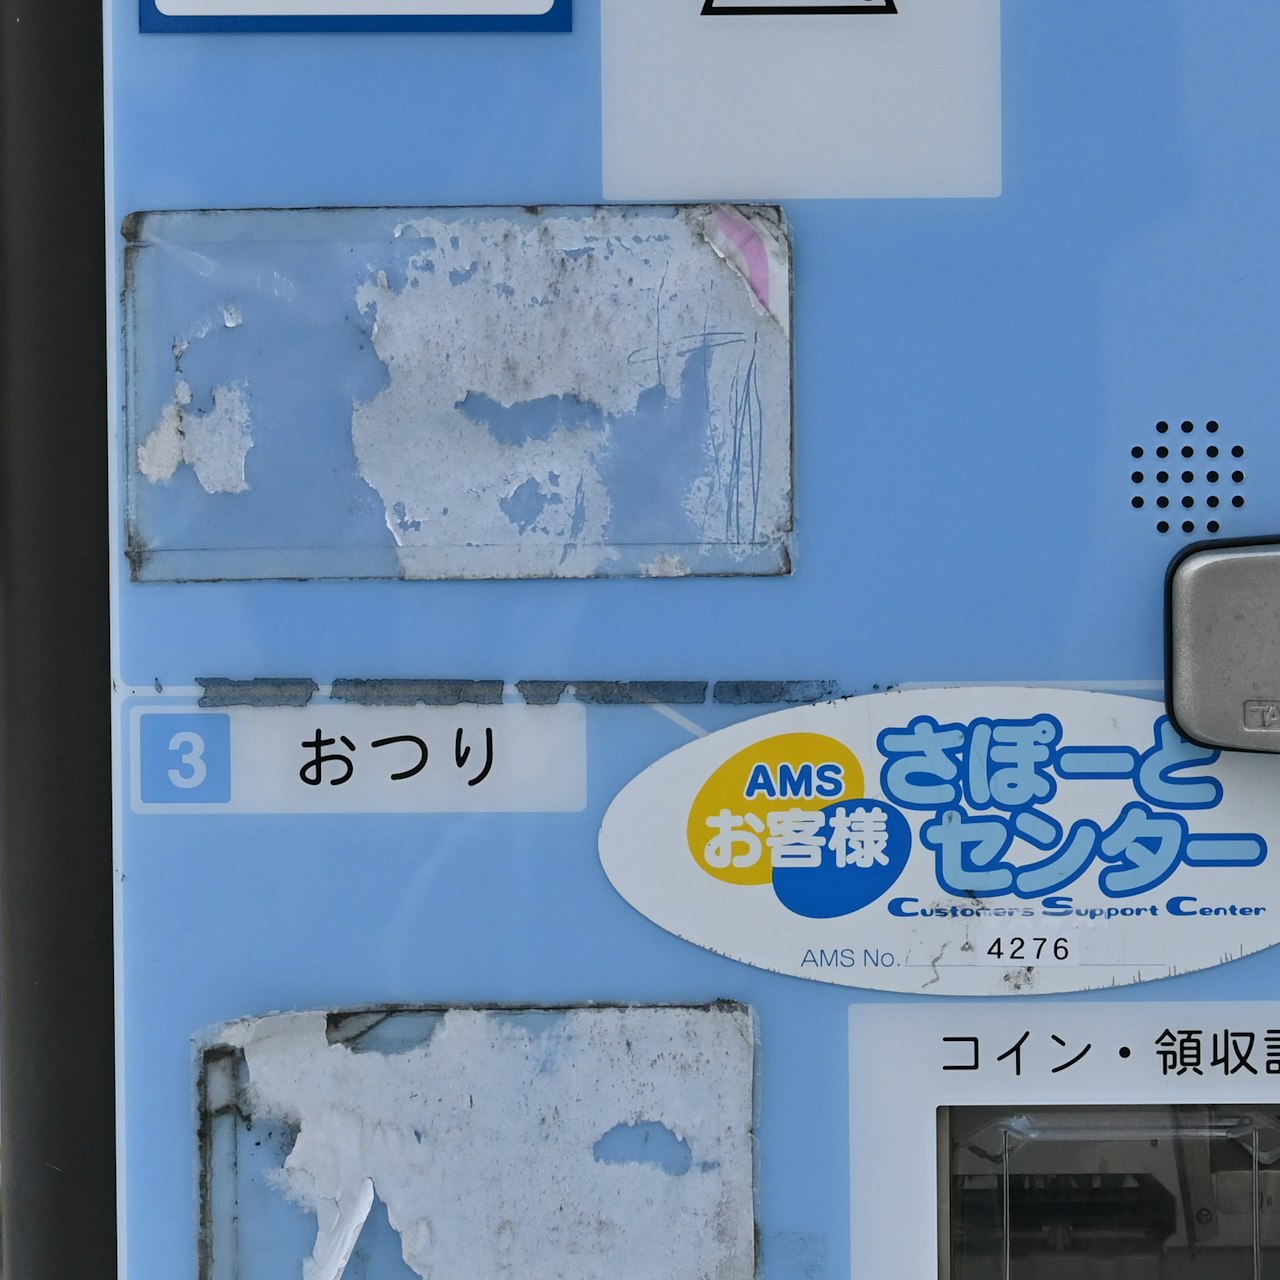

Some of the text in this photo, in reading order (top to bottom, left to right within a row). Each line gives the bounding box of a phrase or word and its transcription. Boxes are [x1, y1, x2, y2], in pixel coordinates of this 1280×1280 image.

[167, 731, 207, 789] 3
[299, 727, 494, 787] おつり
[743, 762, 846, 801] AMS
[877, 714, 1224, 809] さぽーと
[704, 806, 891, 869] お客様
[919, 800, 1269, 901] センター
[1041, 896, 1160, 918] Support
[1166, 895, 1268, 918] Center
[800, 936, 1071, 969] AMS No. 4276
